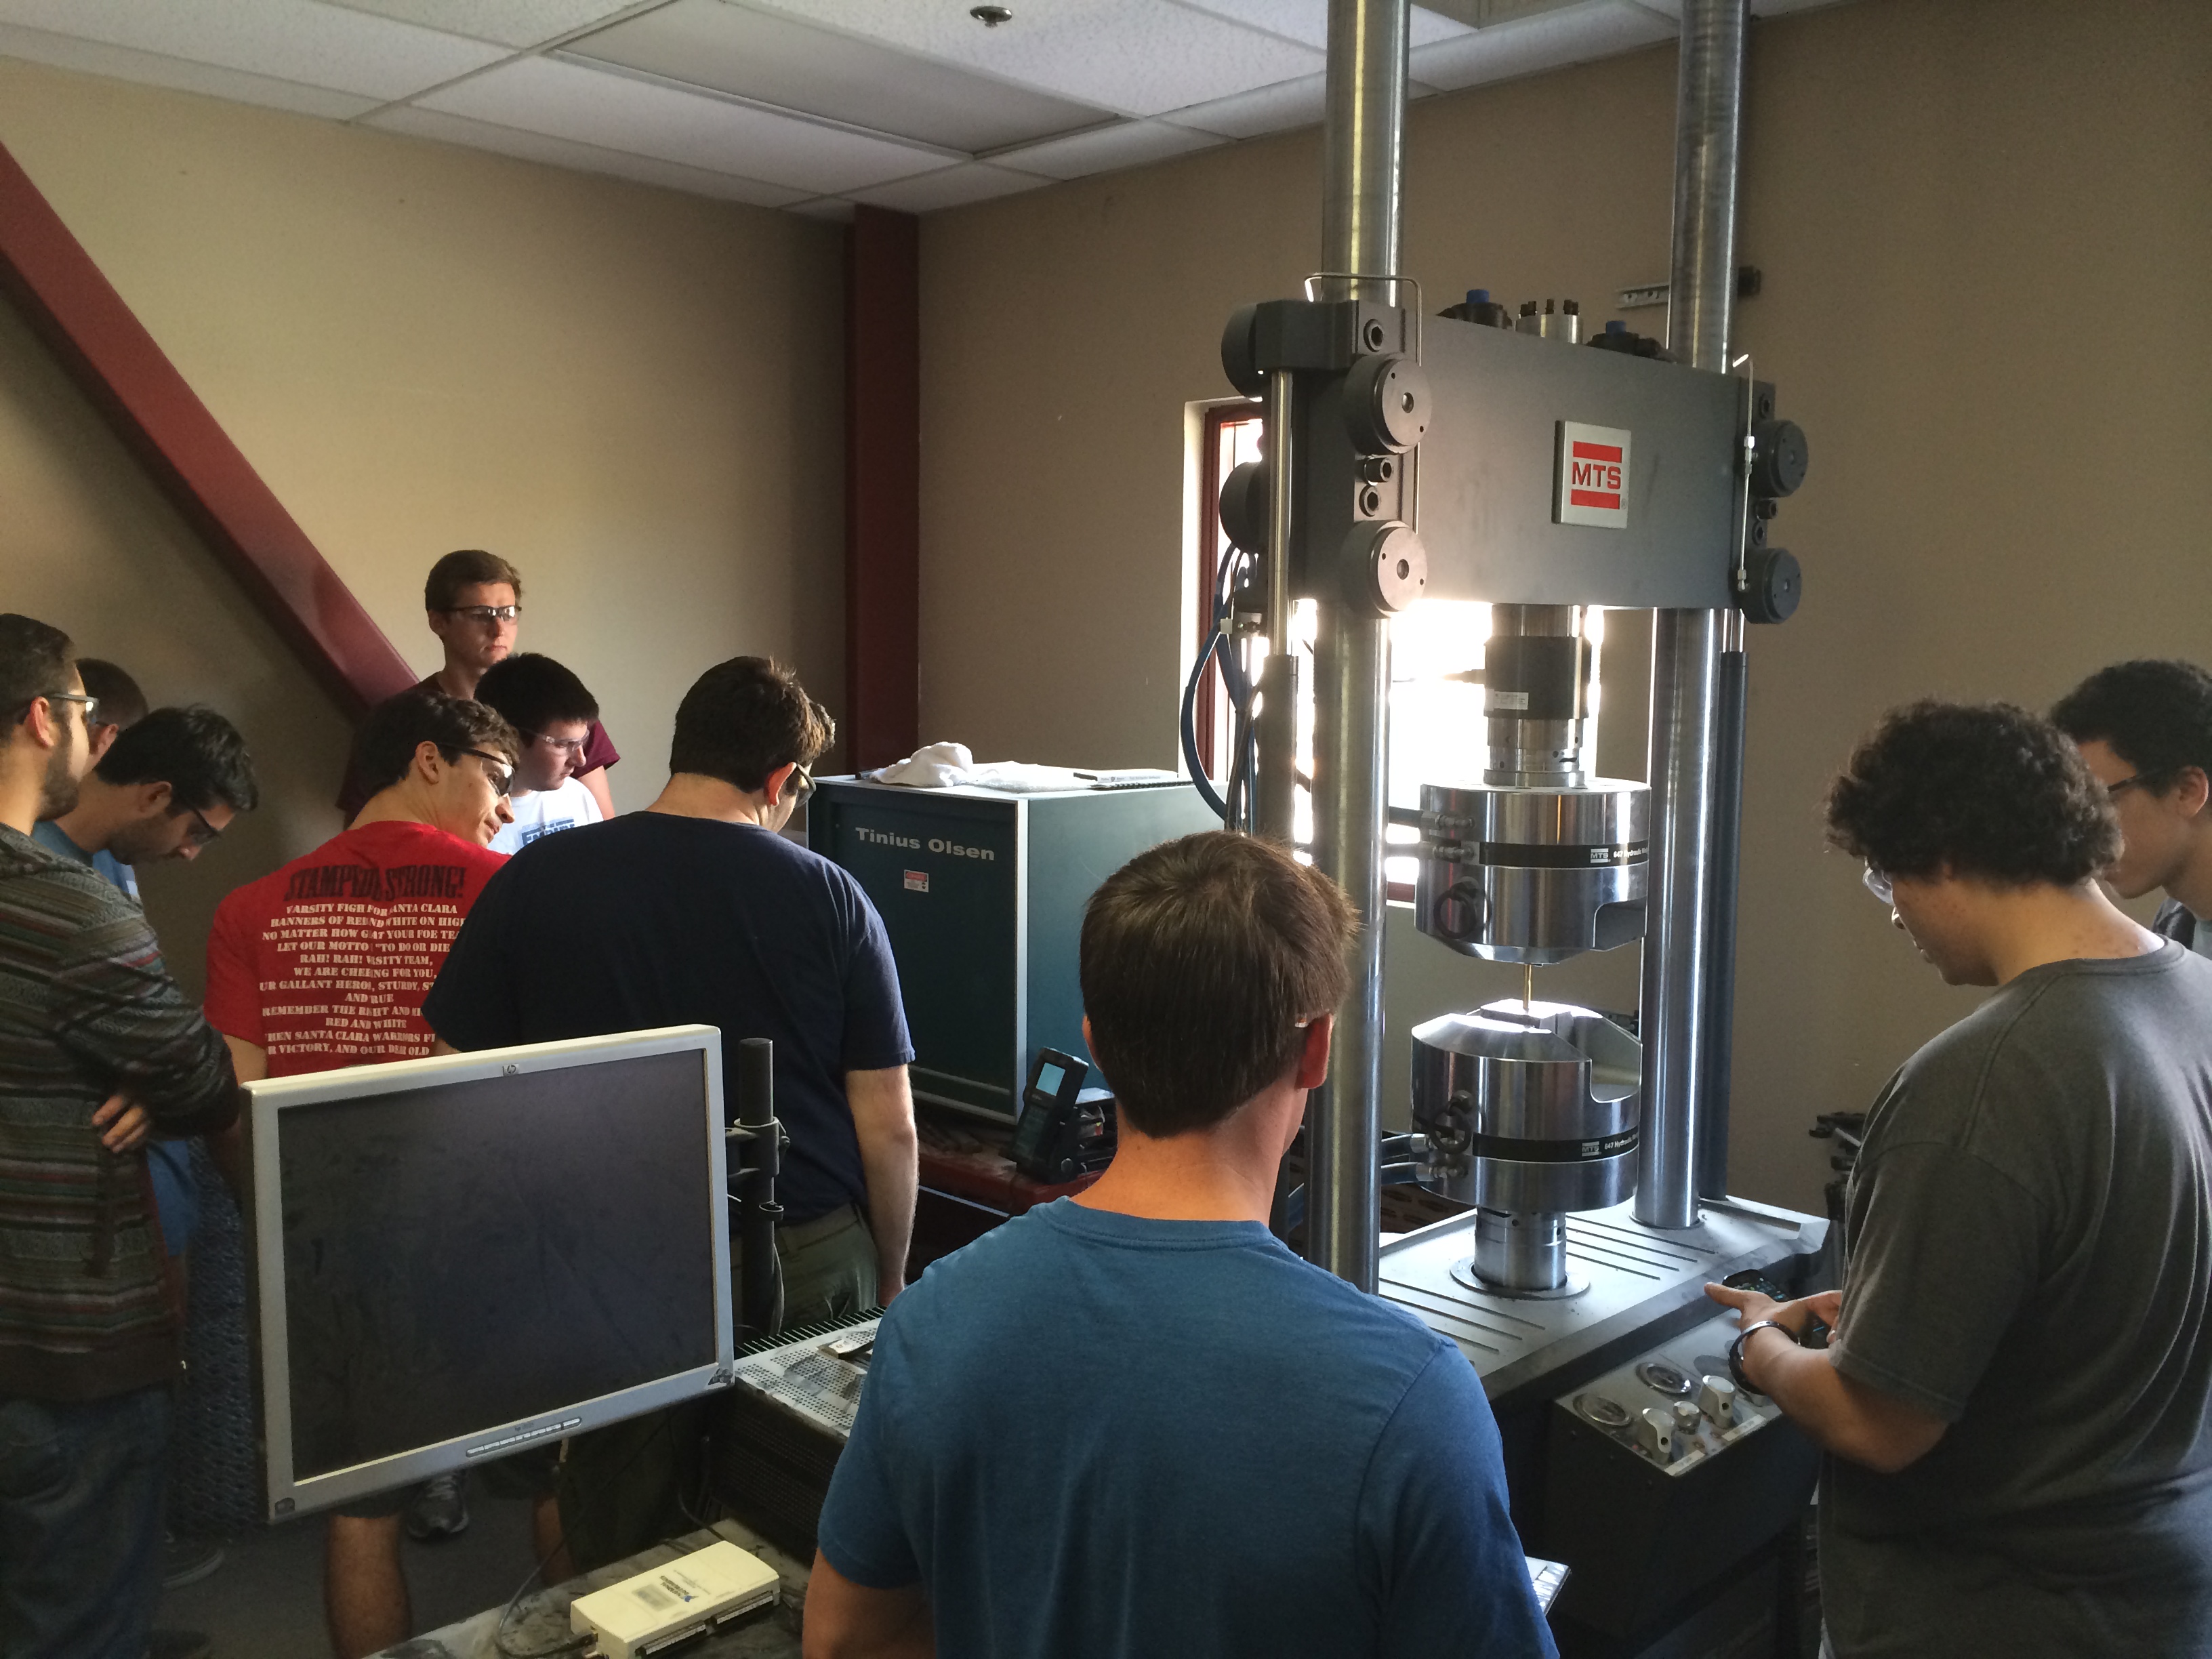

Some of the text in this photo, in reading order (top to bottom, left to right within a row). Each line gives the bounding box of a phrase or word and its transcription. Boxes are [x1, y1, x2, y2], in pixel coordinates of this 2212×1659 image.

[1572, 462, 1621, 489] MTS
[855, 827, 994, 861] Tinius Olsen
[385, 865, 466, 901] STRONG!
[287, 903, 334, 914] VARSITY
[367, 904, 388, 916] FOR
[420, 903, 457, 914] CLARA
[271, 916, 325, 927] BANNERS
[329, 916, 344, 924] OF
[419, 917, 435, 926] ON
[262, 931, 277, 941] NO
[281, 928, 328, 939] MATTER
[331, 928, 359, 937] HOW
[387, 929, 414, 939] YOUR
[417, 929, 438, 939] FOE
[277, 942, 298, 951] LET
[300, 941, 325, 950] OUR
[329, 941, 369, 951] MOTTO
[398, 943, 411, 951] DO
[412, 943, 427, 951] OR
[430, 943, 451, 952] DIE
[300, 954, 329, 963] RAH!
[333, 954, 363, 964] RAH!
[294, 967, 312, 976] WE
[314, 967, 338, 976] ARE
[392, 968, 411, 977] FOR
[279, 980, 332, 989] GALLANT
[345, 993, 368, 1003] AND
[262, 1005, 329, 1017] REMEMBER
[332, 1005, 356, 1015] THE
[392, 1006, 410, 1016] AND
[325, 1017, 407, 1029] RED AND WHITE
[295, 1030, 333, 1040] SANTA
[335, 1031, 369, 1042] CLARA
[279, 1043, 333, 1054] VICTORY,
[335, 1044, 358, 1054] AND
[360, 1044, 385, 1054] OUR
[408, 1046, 430, 1056] OLD
[1604, 1142, 1614, 1150] 647
